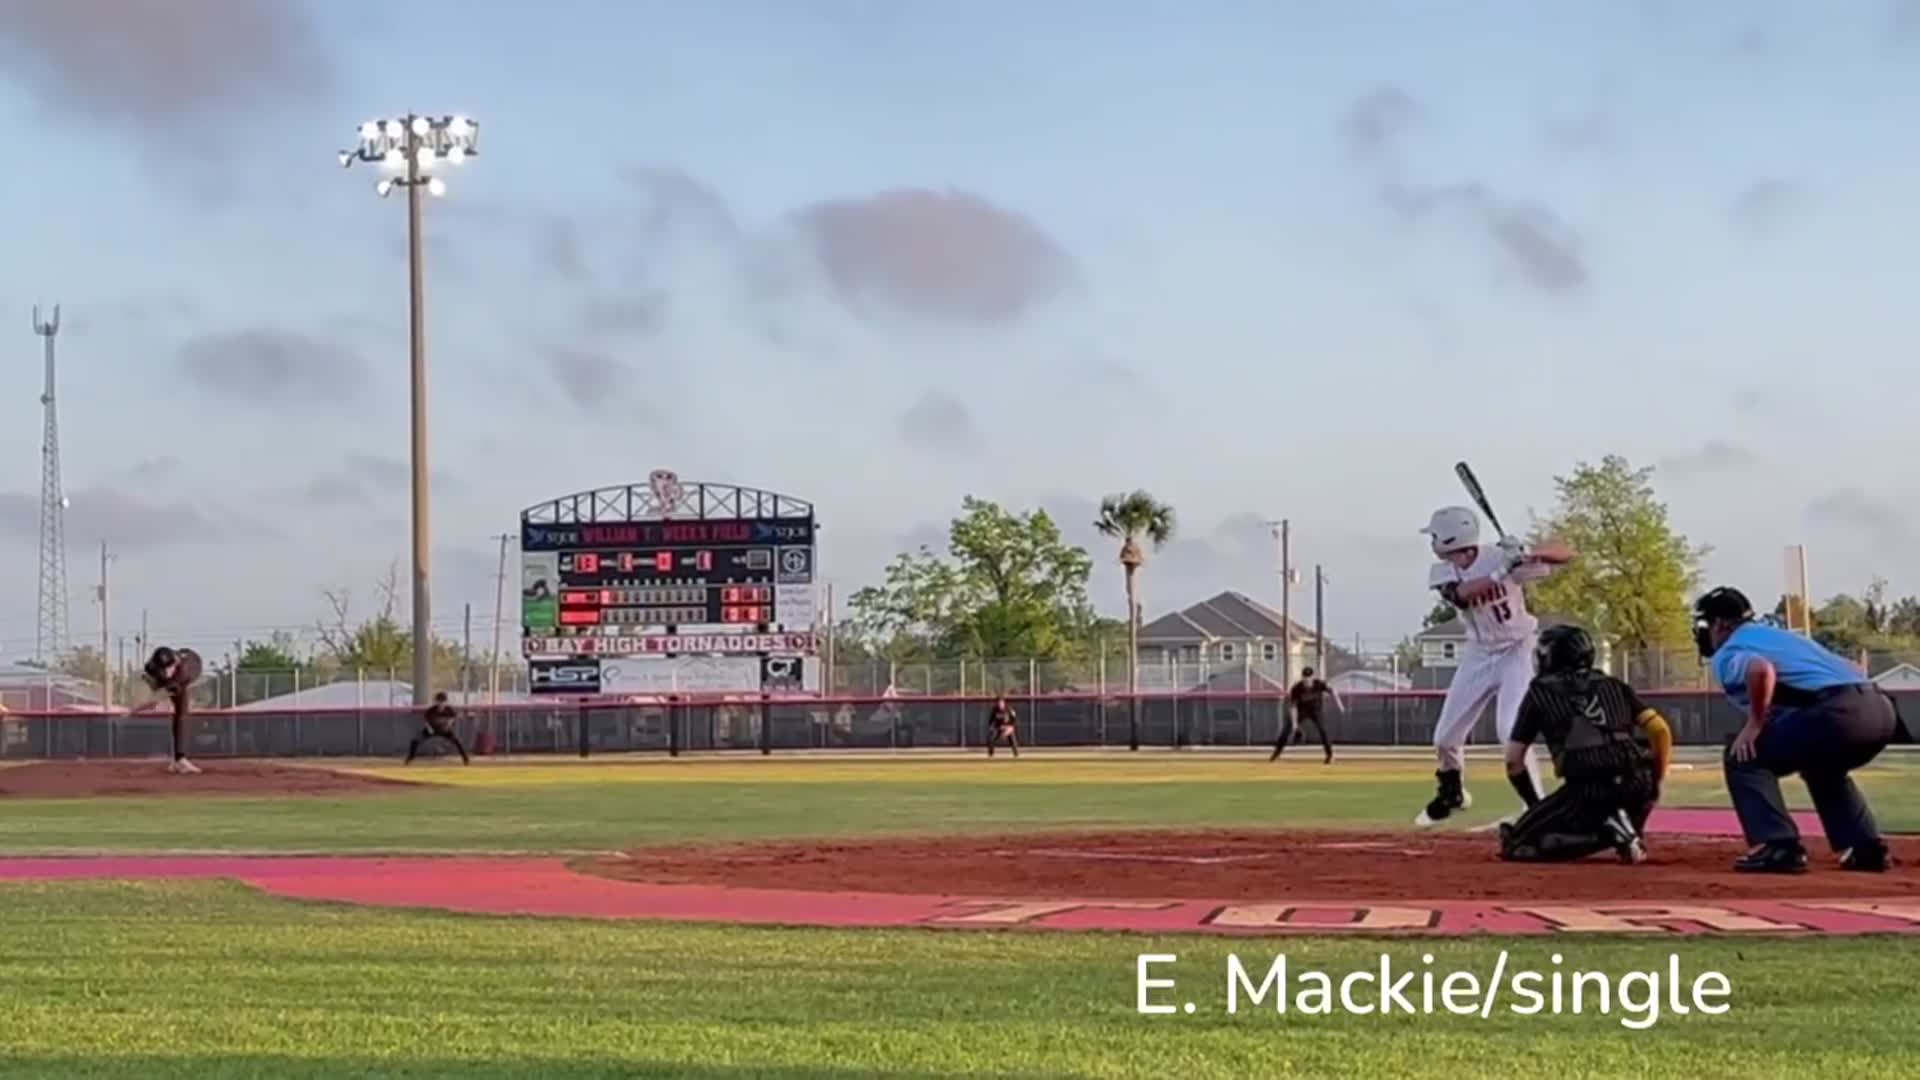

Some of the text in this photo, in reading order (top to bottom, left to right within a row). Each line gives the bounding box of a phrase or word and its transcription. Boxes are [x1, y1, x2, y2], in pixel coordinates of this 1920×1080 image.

[1491, 600, 1511, 624] 13
[545, 636, 786, 652] BAY HIGH TORNADOES
